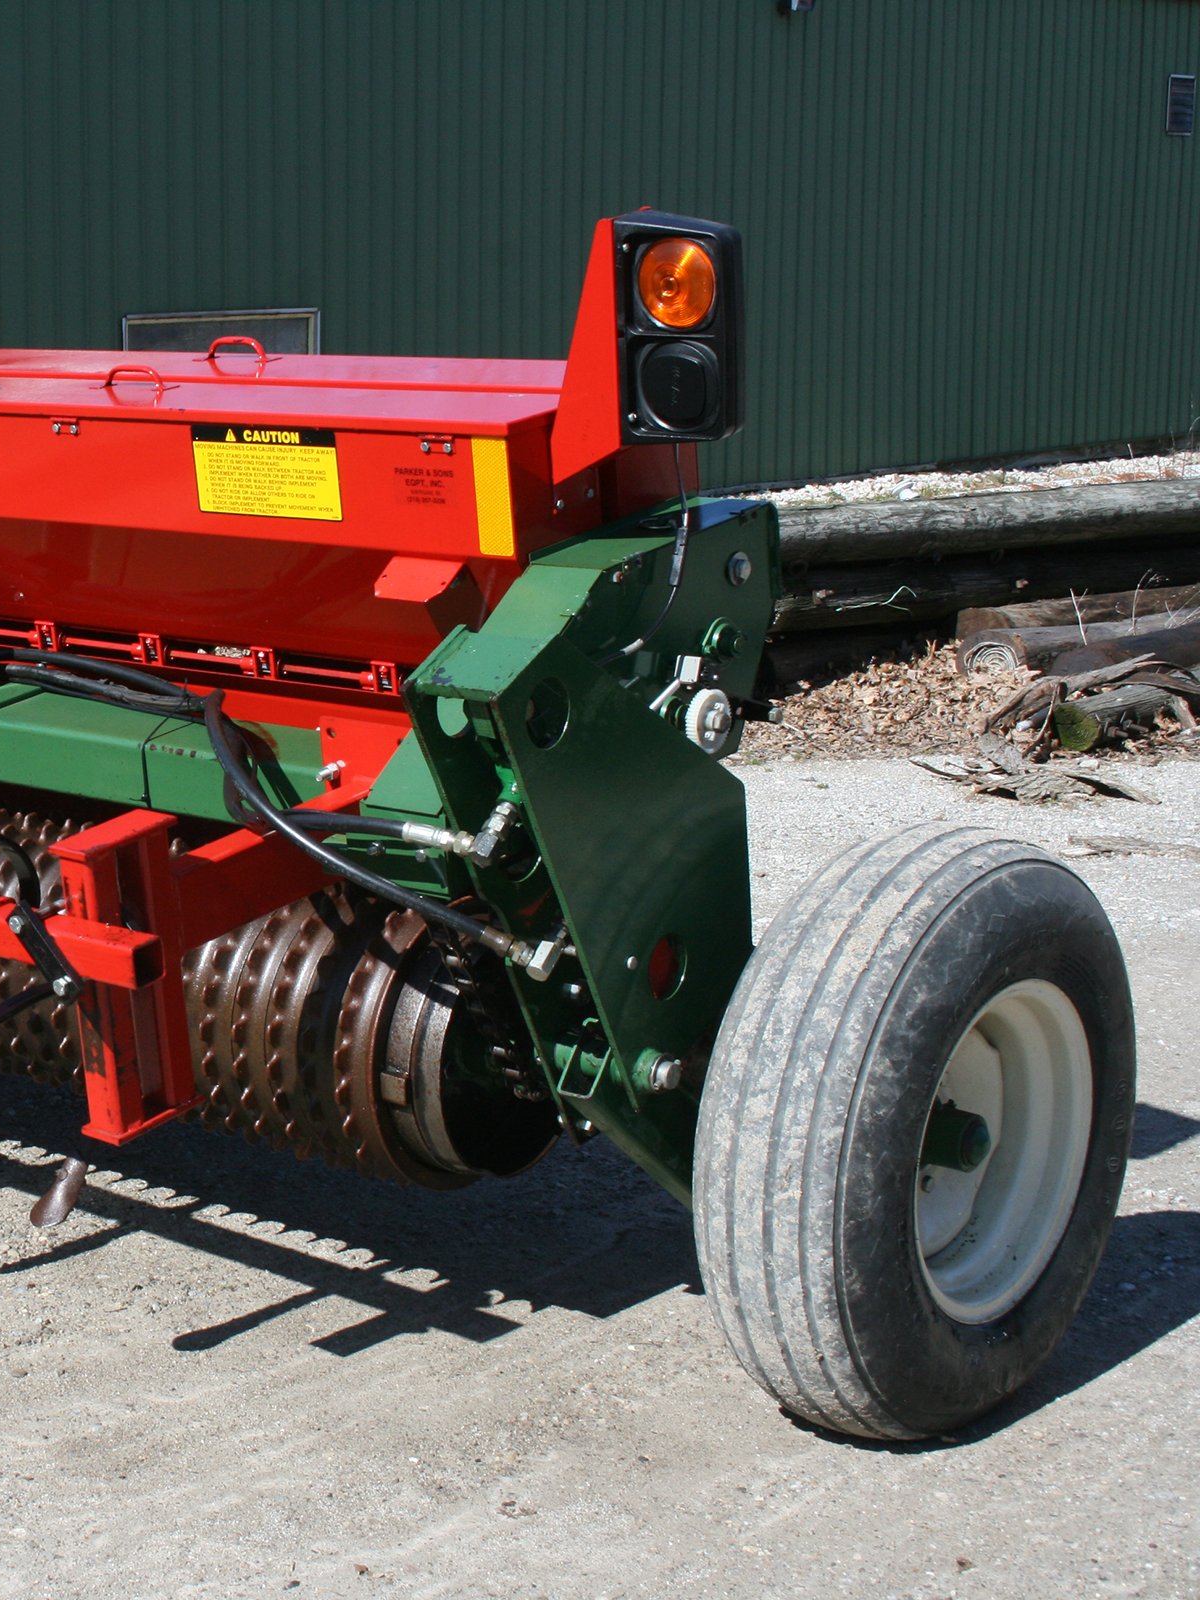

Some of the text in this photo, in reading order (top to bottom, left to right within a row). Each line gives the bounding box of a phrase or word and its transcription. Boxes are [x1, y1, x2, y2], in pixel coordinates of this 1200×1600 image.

[243, 430, 299, 443] CAUTION
[394, 467, 454, 478] PARKER & SONS
